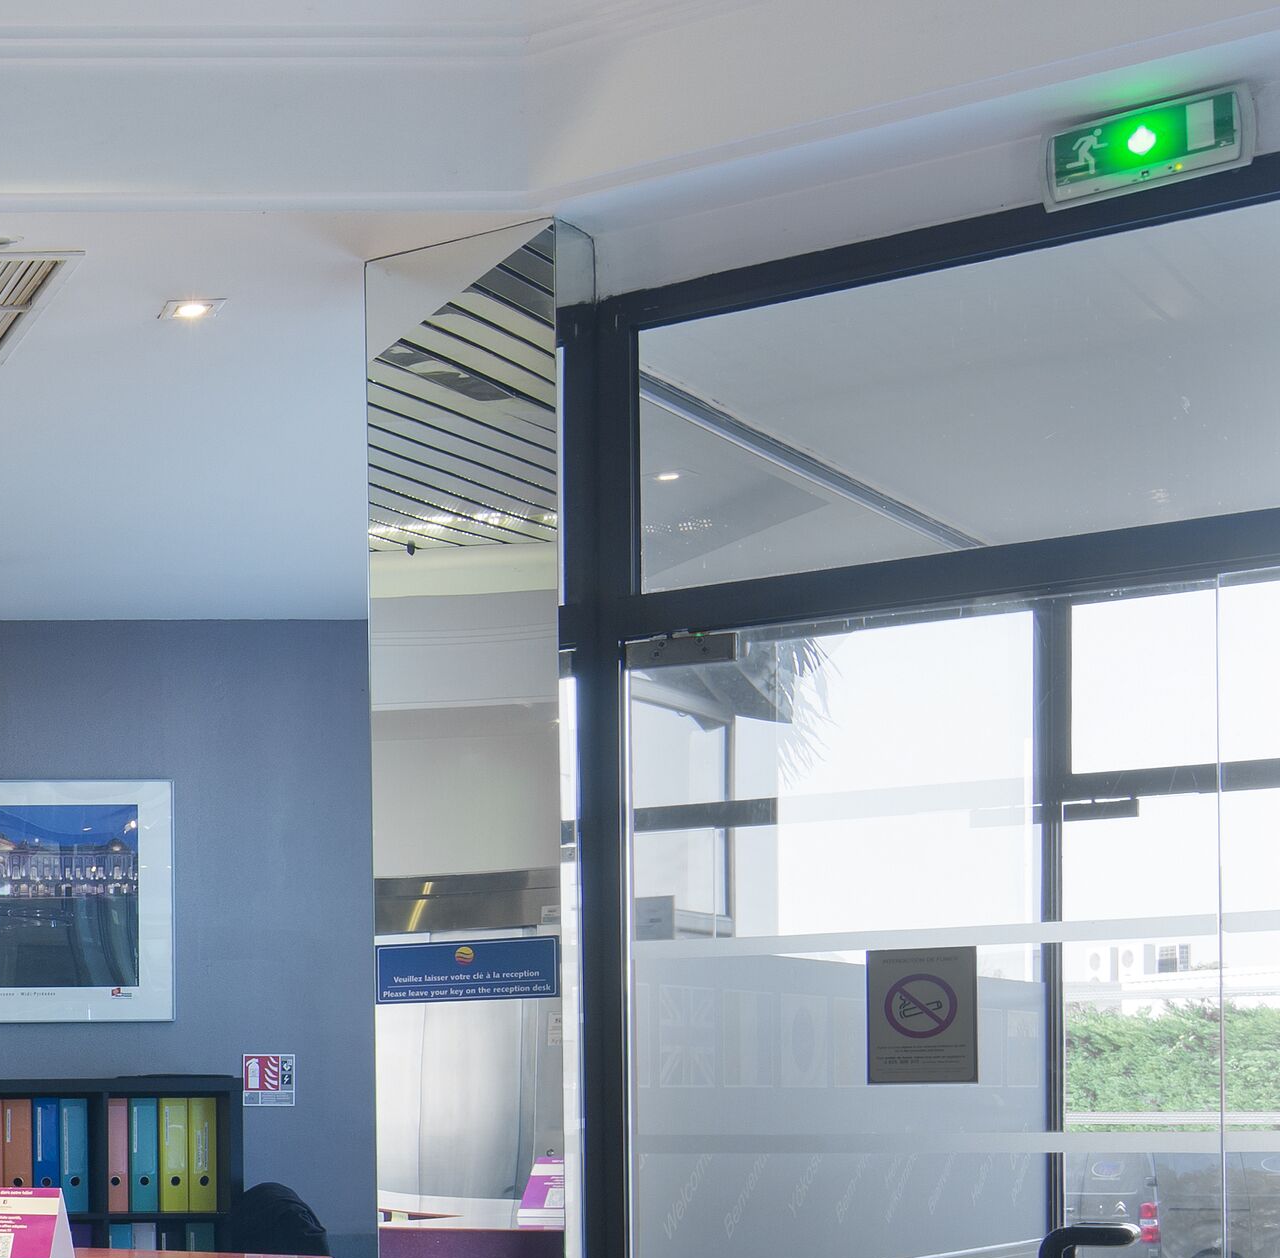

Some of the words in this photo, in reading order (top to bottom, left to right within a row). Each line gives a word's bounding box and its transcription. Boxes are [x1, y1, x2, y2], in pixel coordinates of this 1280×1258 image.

[393, 974, 423, 984] Veuillez
[424, 974, 448, 982] laisser
[450, 973, 470, 981] votre
[502, 970, 540, 979] reception
[383, 990, 407, 998] Please
[408, 989, 429, 997] leave
[430, 989, 448, 998] your
[450, 987, 463, 996] key
[478, 986, 491, 994] the
[493, 985, 530, 994] reception
[532, 984, 551, 992] desk
